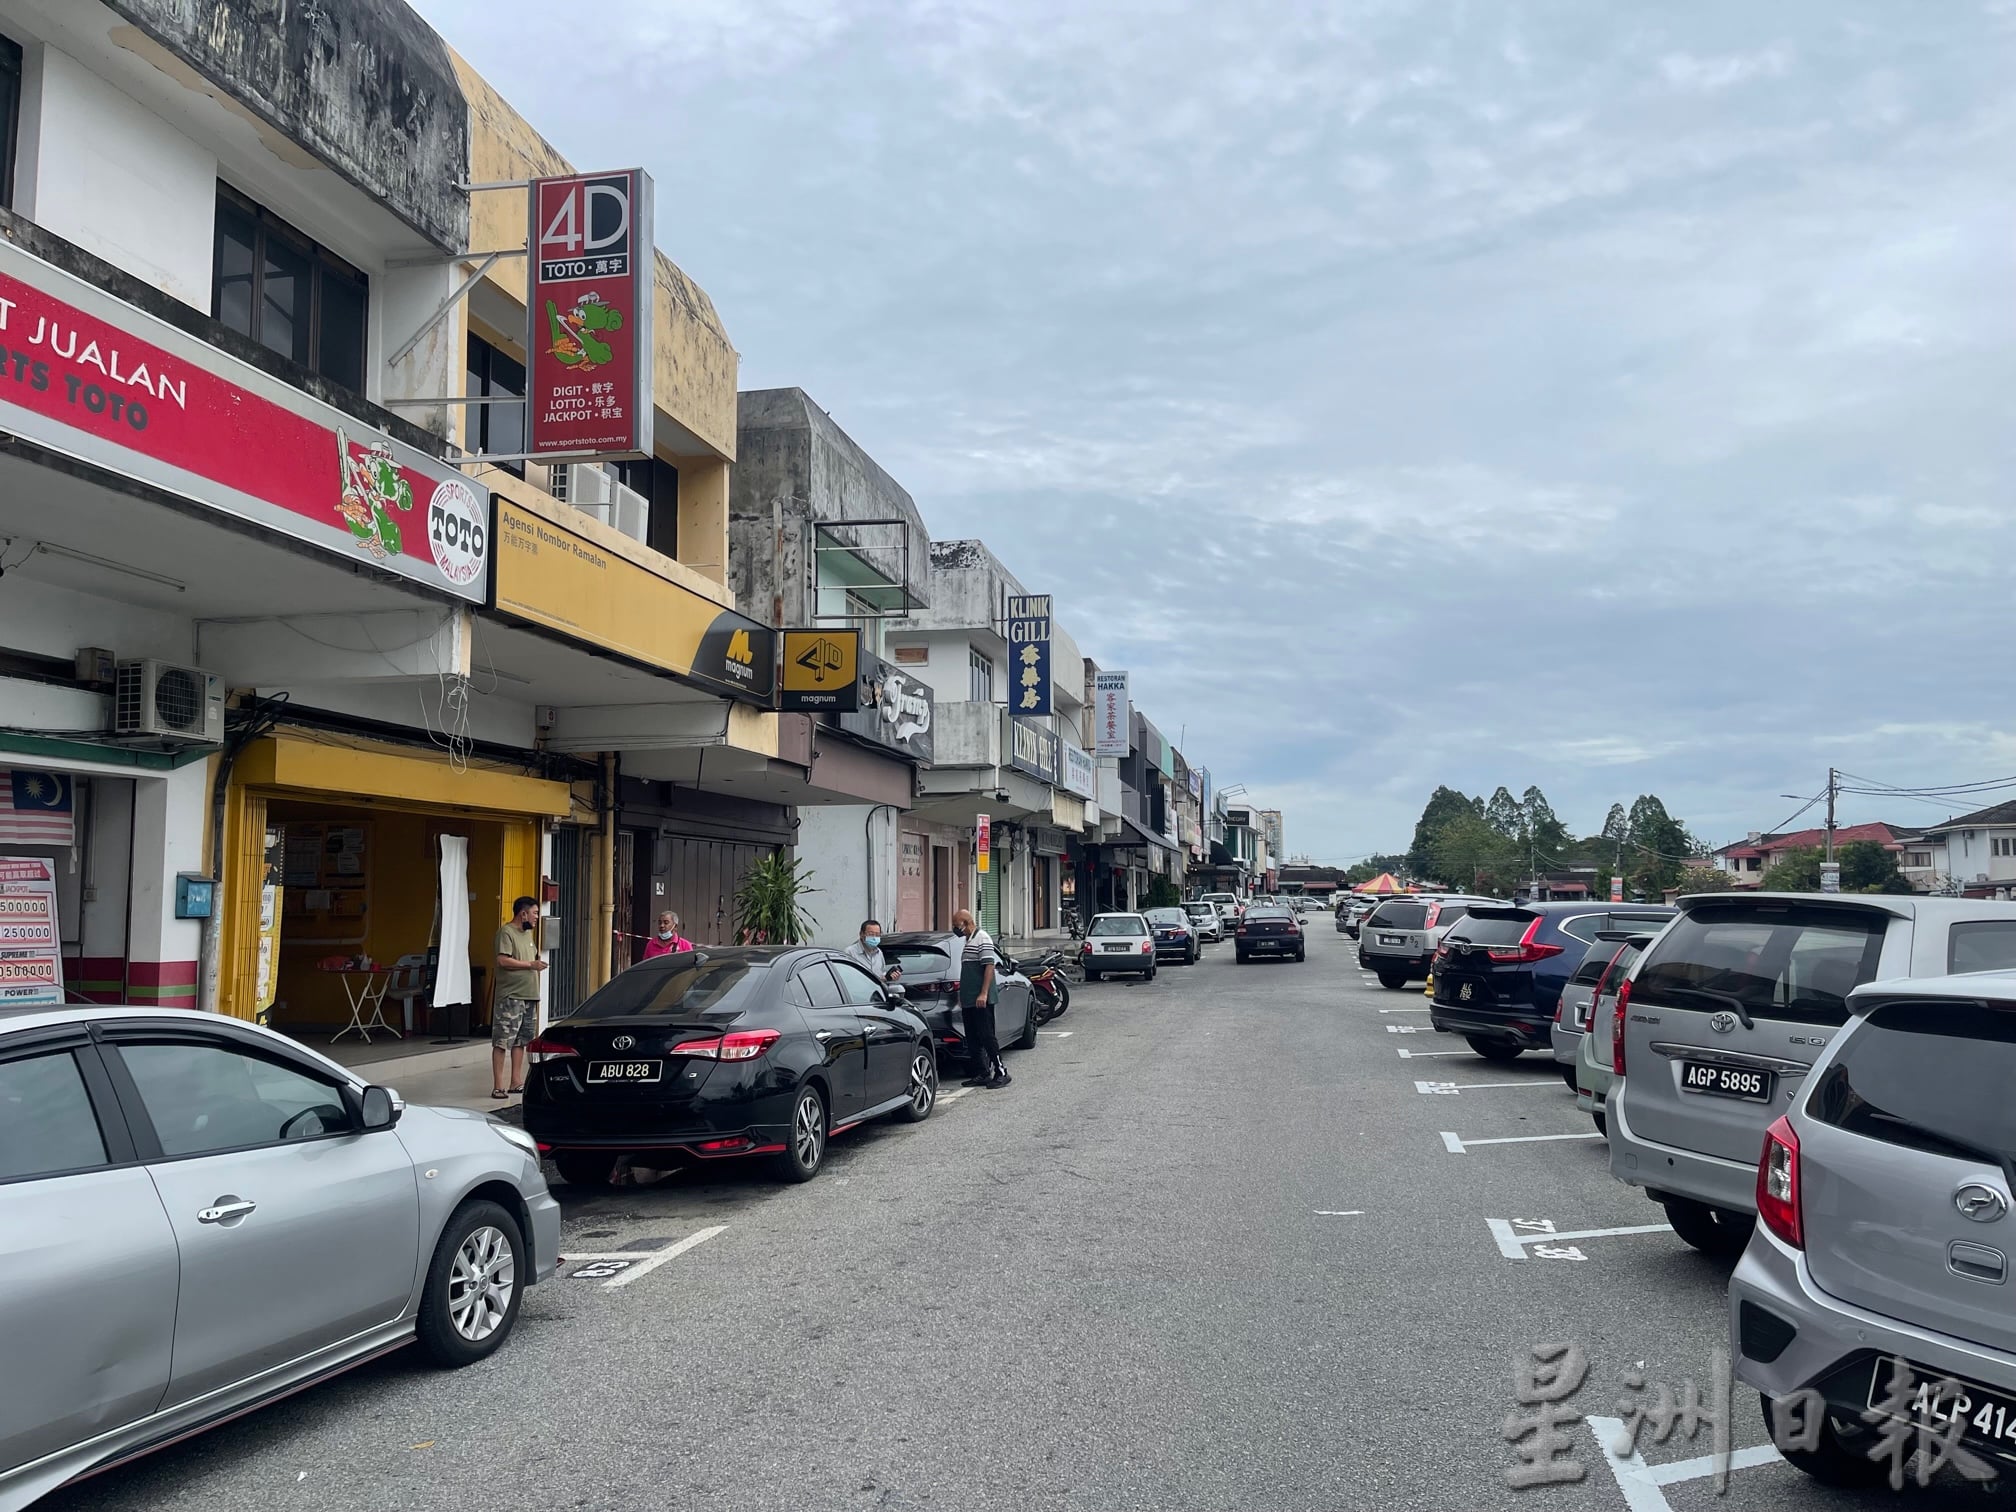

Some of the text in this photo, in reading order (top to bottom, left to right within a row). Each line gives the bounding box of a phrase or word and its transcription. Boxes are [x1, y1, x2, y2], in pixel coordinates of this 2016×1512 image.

[541, 184, 629, 252] 4D
[545, 259, 623, 278] TOTO 萬字
[28, 316, 186, 411] JUALAN
[65, 373, 148, 431] TOTO
[553, 385, 583, 397] DIGIT
[550, 398, 585, 410] LOTTO
[543, 410, 592, 423] JACKPOT
[538, 435, 628, 447] www.sportstoto.com.my
[431, 504, 484, 558] TOTO
[503, 511, 607, 569] Agensi Nombor Ramalan
[1010, 596, 1049, 619] KLINIK
[1010, 620, 1050, 643] GILL
[725, 658, 753, 680] magnum
[1097, 682, 1125, 690] HAKKA
[801, 695, 836, 705] magnum
[1013, 720, 1038, 766] KLINIK
[1039, 735, 1053, 773] GILL
[4, 988, 34, 997] POWER
[600, 1063, 649, 1078] ABU 828
[1687, 1065, 1761, 1094] AGP 5895
[1911, 1381, 1972, 1424] ALP
